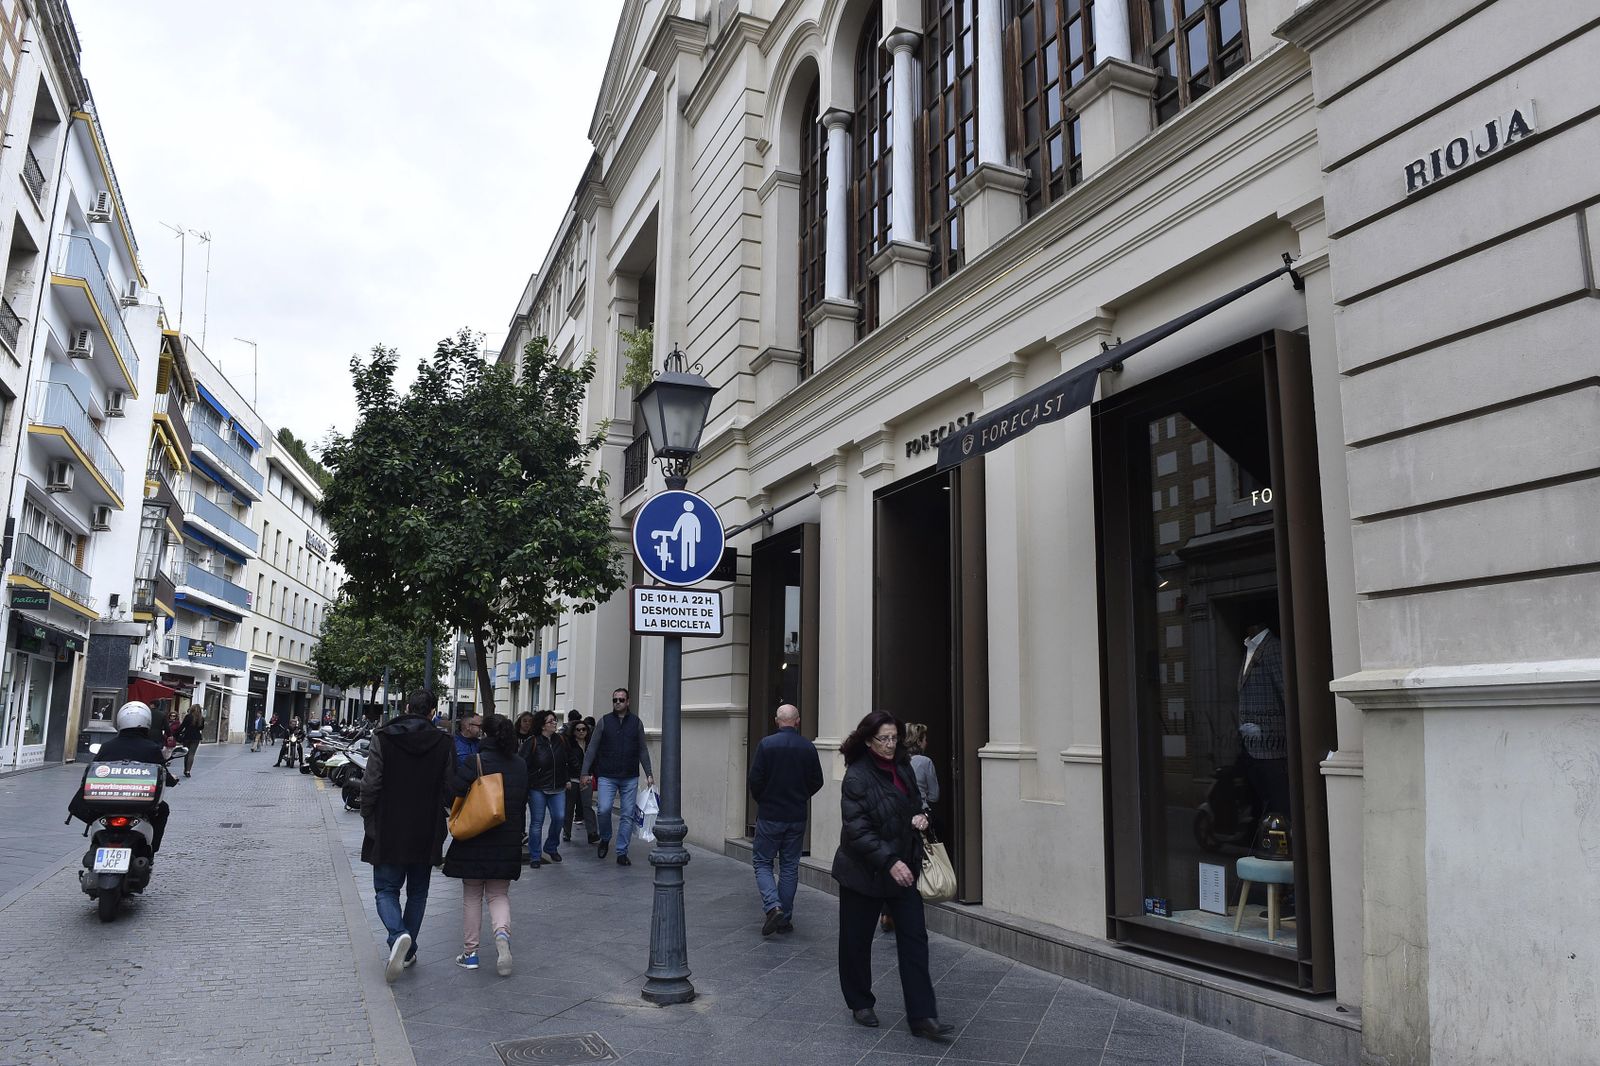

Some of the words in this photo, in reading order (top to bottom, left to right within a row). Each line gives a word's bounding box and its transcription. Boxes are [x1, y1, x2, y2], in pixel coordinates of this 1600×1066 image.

[1404, 109, 1534, 193] RIOJA
[981, 393, 1065, 447] FORECAST
[905, 411, 975, 458] FORECAST
[641, 593, 654, 602] DE
[657, 594, 668, 603] 10
[669, 595, 679, 603] H.
[682, 596, 688, 604] A
[692, 596, 703, 604] 22
[705, 597, 714, 605] H.
[642, 606, 698, 616] DESMONTE
[701, 608, 714, 617] DE
[645, 619, 657, 628] LA
[661, 620, 711, 629] BICICLETA
[111, 767, 121, 775] EN
[106, 850, 127, 859] 1461
